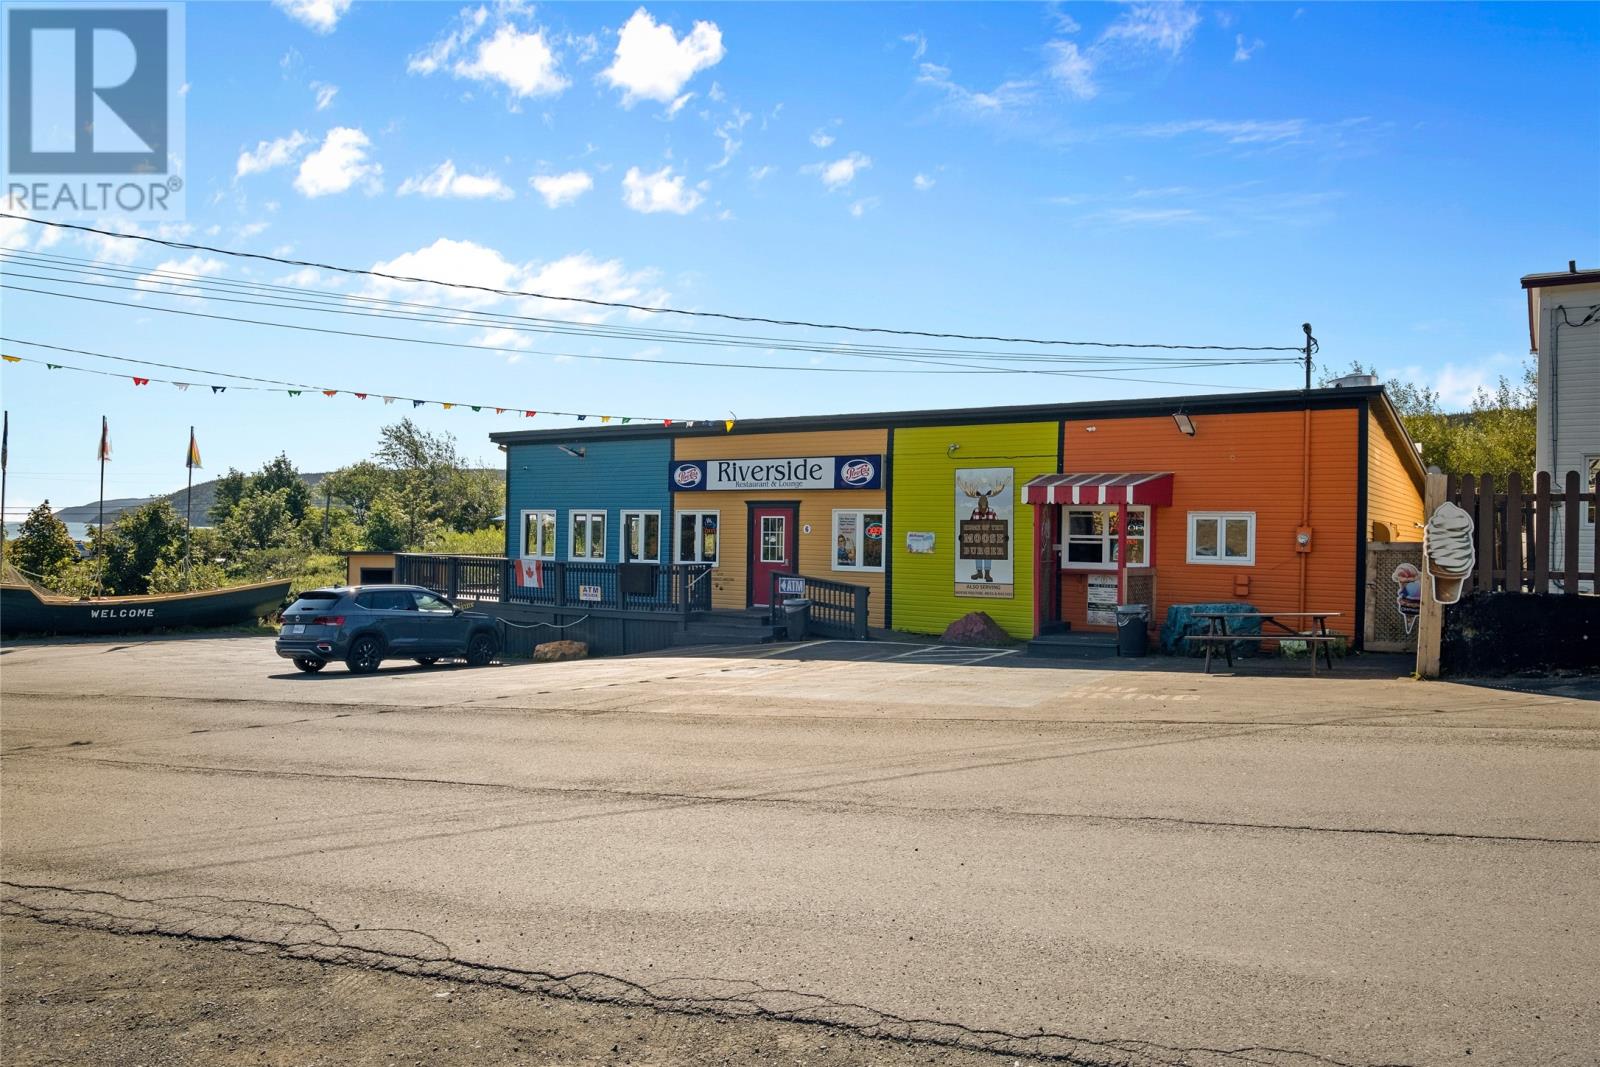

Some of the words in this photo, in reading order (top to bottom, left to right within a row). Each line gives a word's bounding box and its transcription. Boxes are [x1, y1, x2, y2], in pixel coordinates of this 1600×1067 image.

[718, 459, 823, 482] Riverside
[963, 534, 1004, 543] MOOSE
[963, 547, 1004, 555] BURGER
[786, 581, 803, 592] ATM
[91, 608, 155, 619] WELCOME
